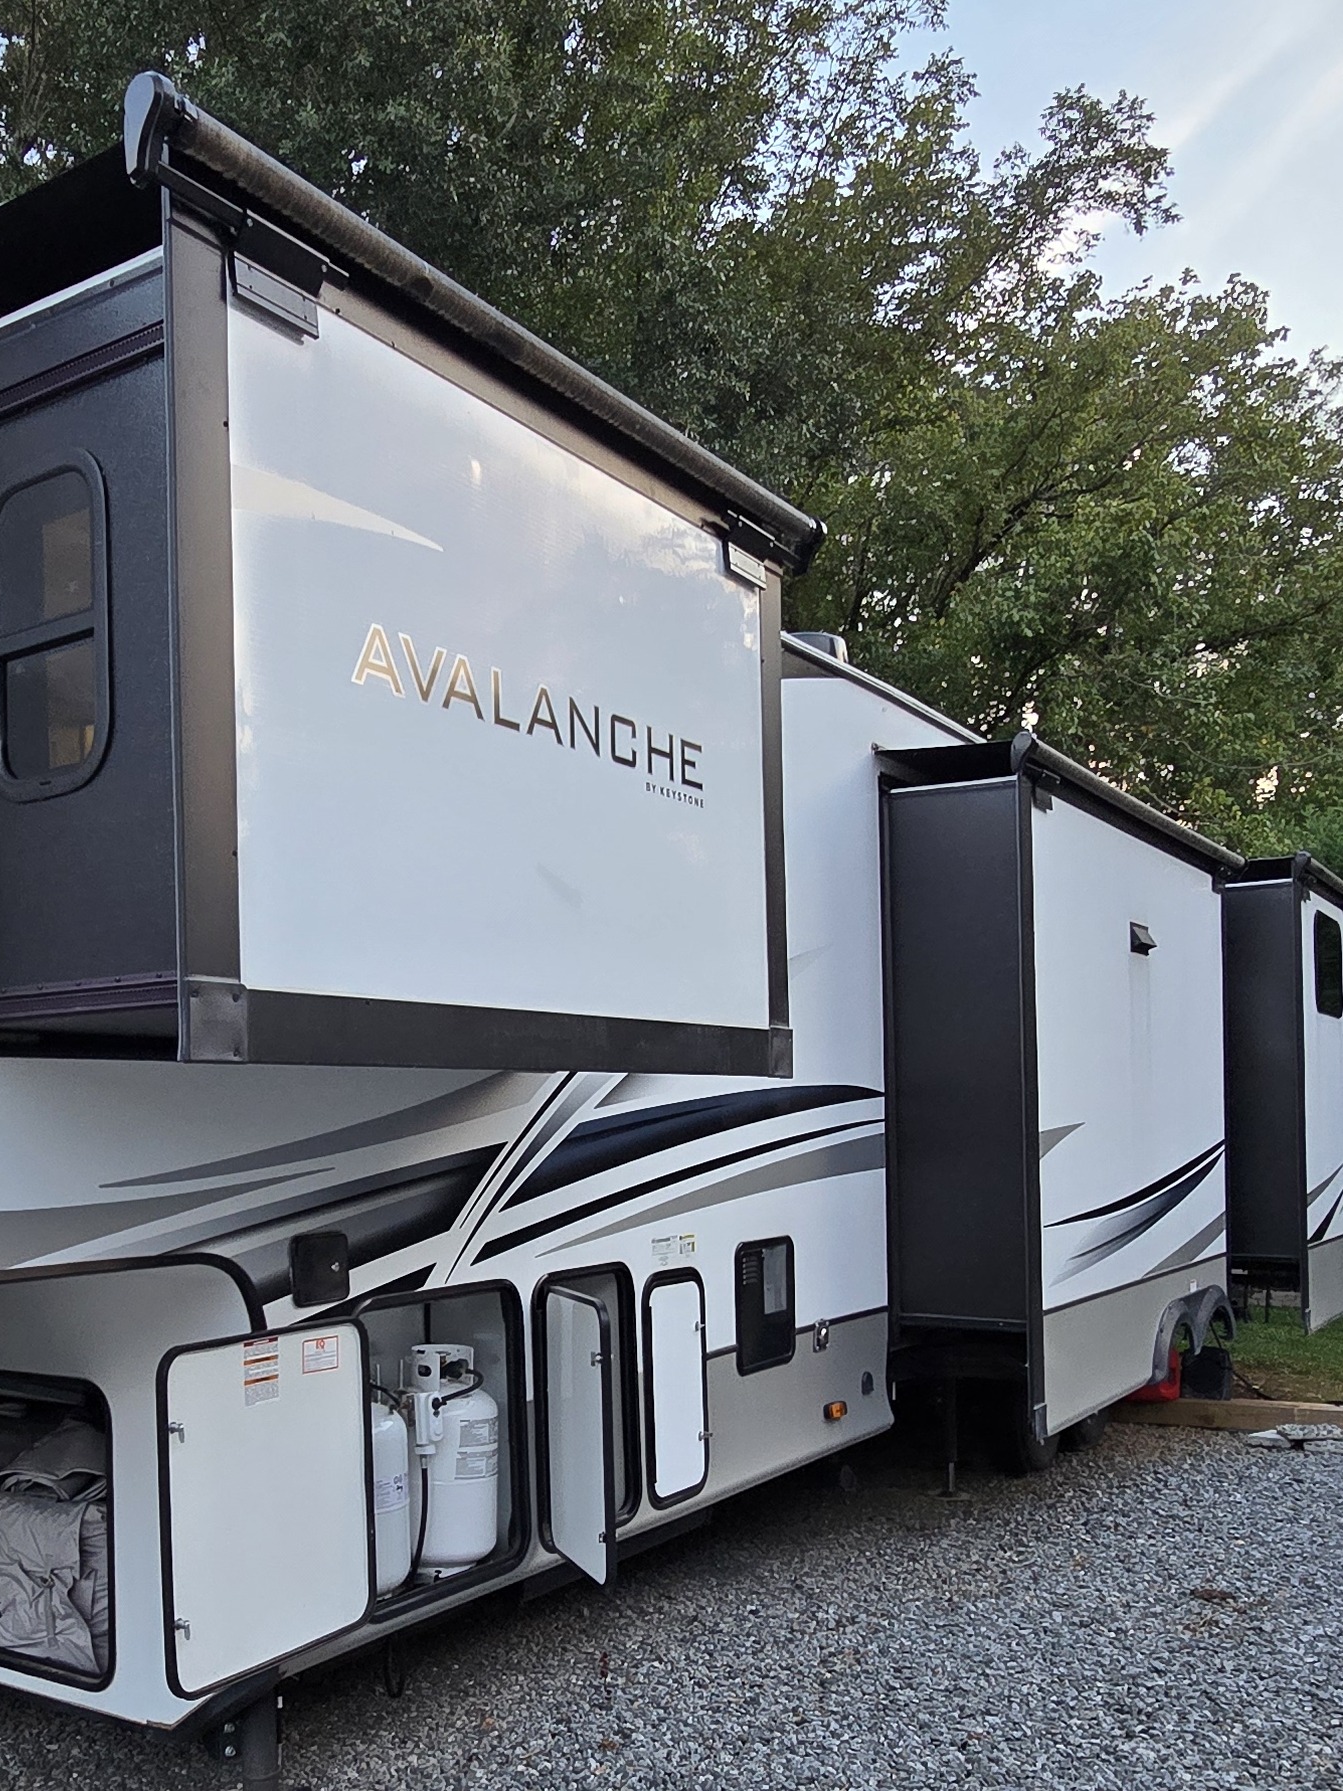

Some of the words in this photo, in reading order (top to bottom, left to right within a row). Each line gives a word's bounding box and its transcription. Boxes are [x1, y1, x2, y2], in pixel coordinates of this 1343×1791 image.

[352, 623, 703, 790] AVALANCHE
[645, 782, 657, 793] BY
[659, 786, 704, 808] KEYSTONE
